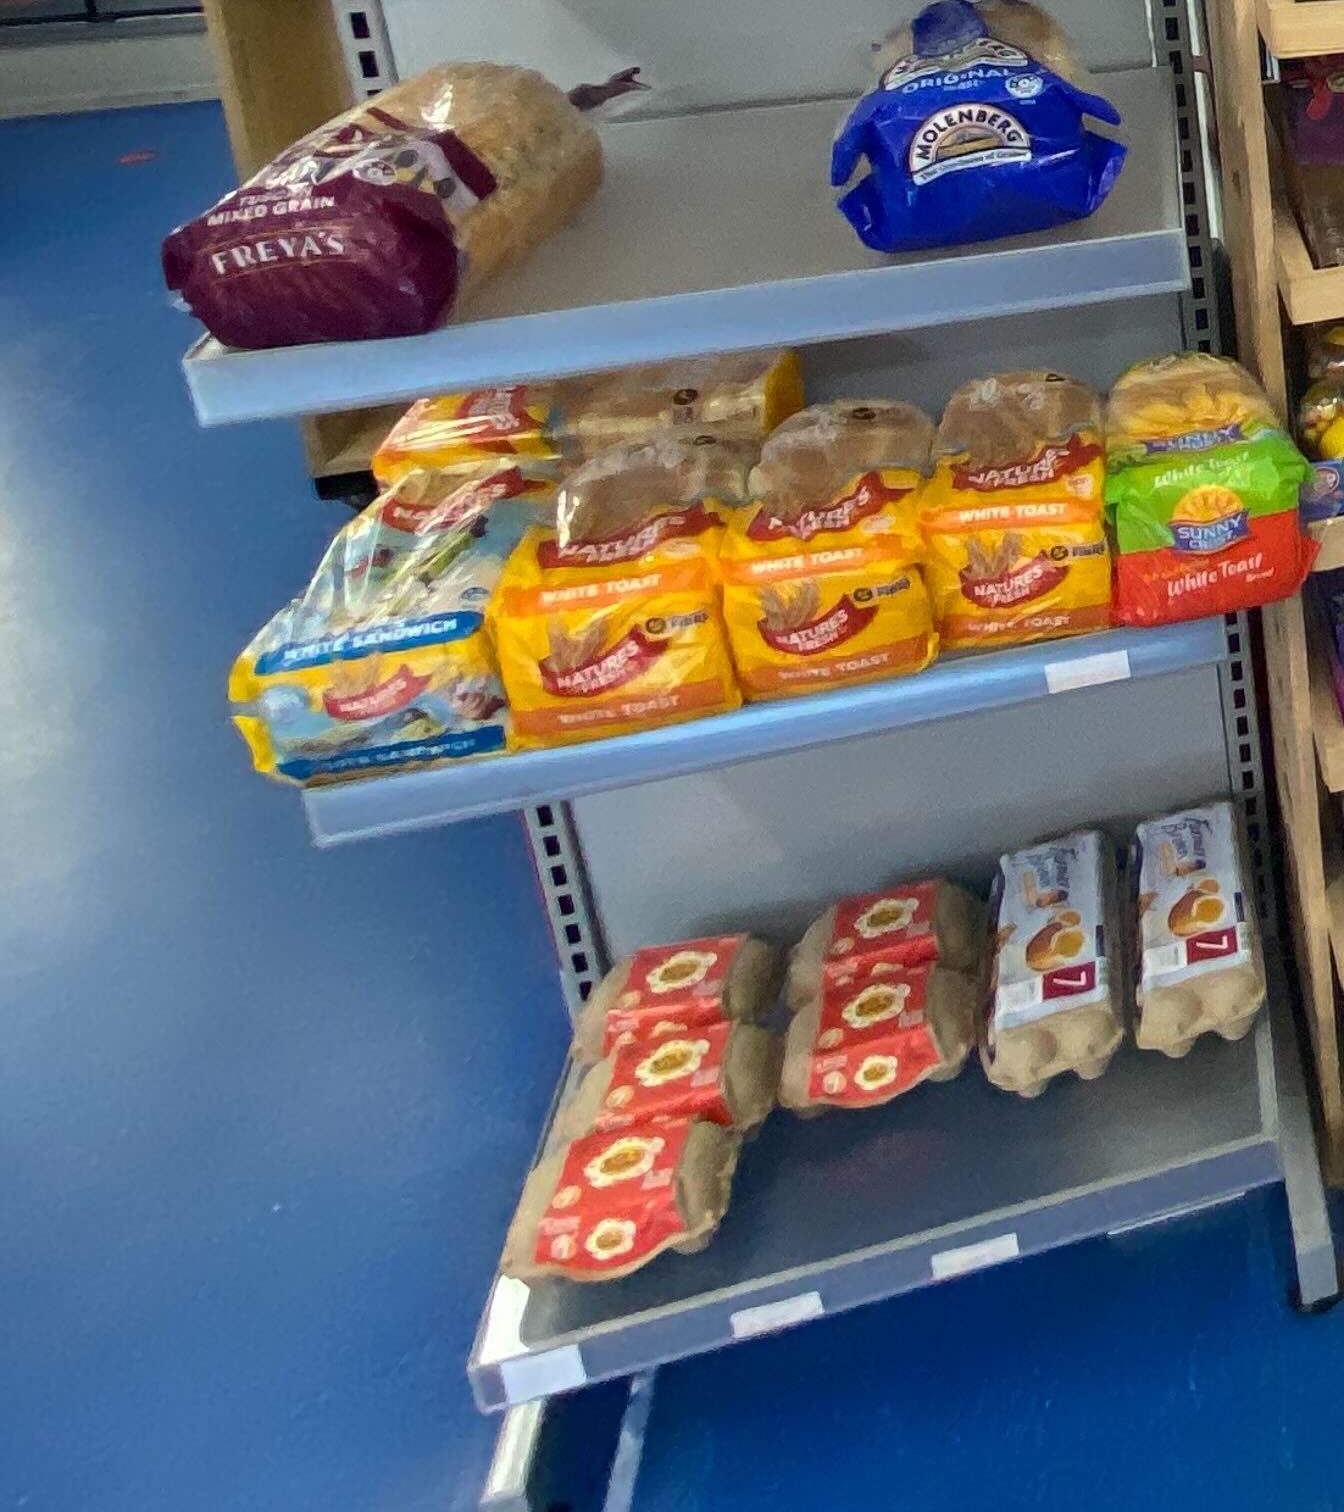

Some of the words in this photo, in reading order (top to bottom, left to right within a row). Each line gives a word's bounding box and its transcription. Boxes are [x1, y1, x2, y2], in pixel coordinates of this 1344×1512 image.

[916, 109, 1024, 160] MOLENBERG
[207, 203, 267, 227] MIXED
[272, 195, 336, 216] GRAIN
[211, 231, 345, 276] FREYA'S
[959, 507, 1009, 523] WHITE
[1015, 503, 1068, 519] TOAST
[1177, 512, 1243, 540] SUNNY
[750, 556, 804, 574] WHITE
[811, 547, 864, 565] TOAST
[607, 573, 661, 594] TOAST
[1167, 569, 1218, 597] White
[836, 652, 890, 673] TOAST
